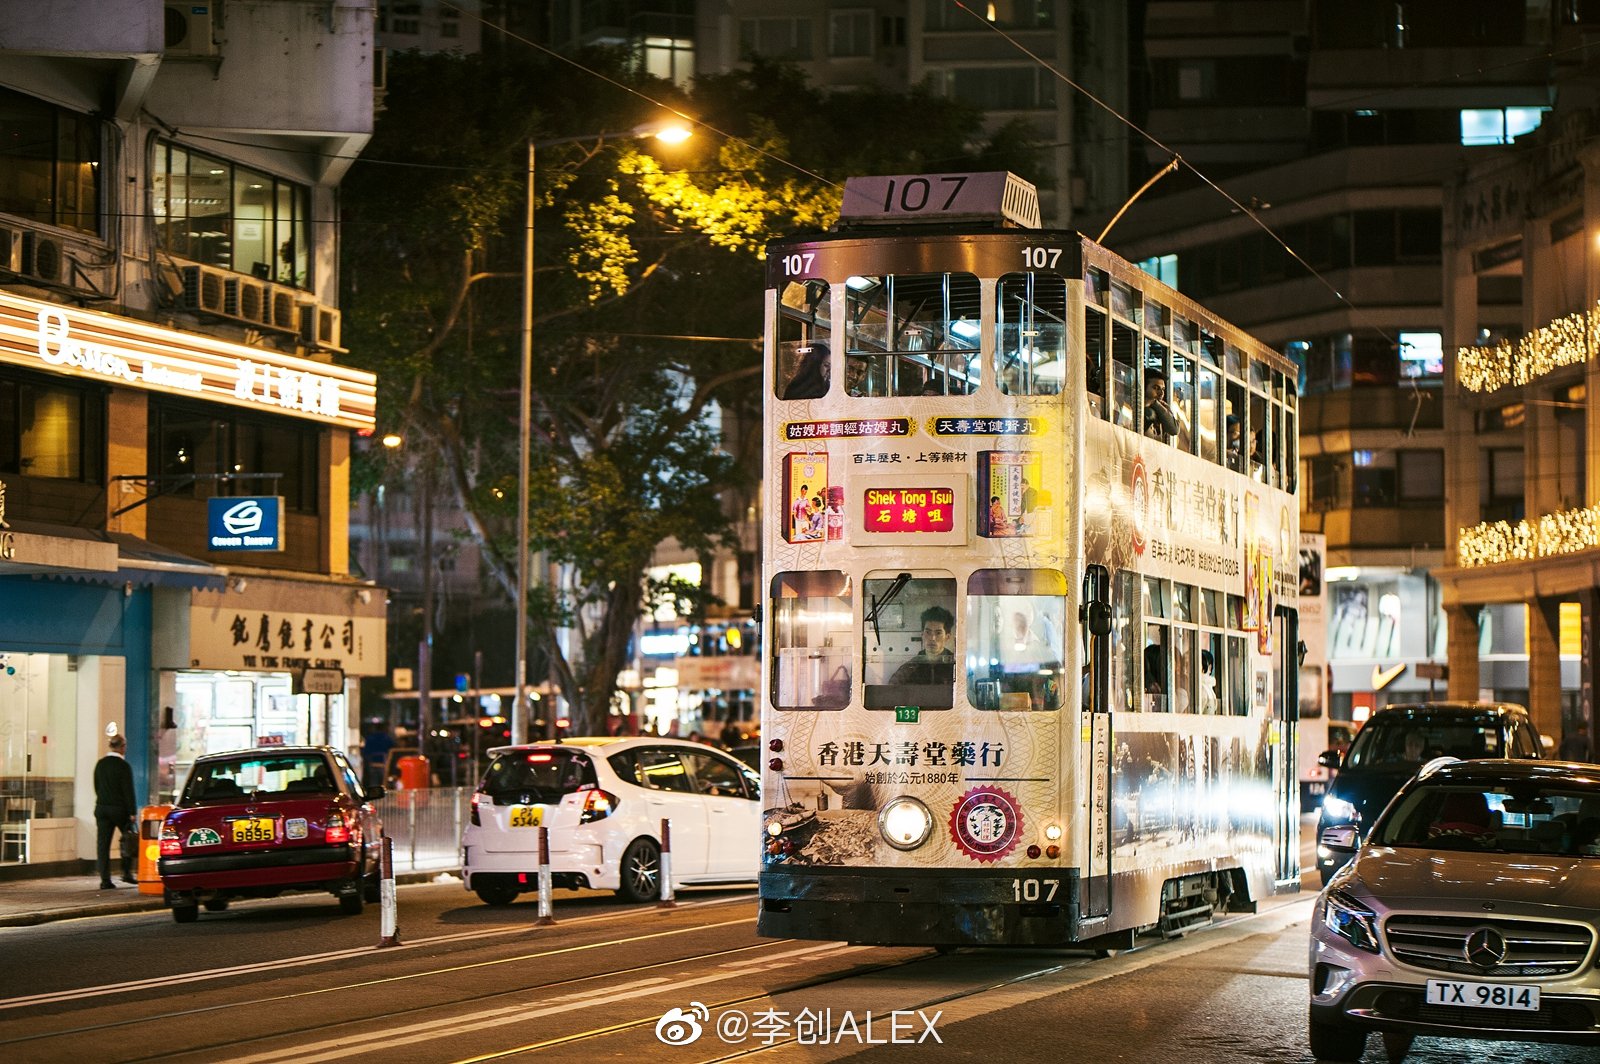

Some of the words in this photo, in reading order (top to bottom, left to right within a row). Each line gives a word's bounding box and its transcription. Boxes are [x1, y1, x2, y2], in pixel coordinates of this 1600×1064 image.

[883, 176, 968, 213] 107
[781, 253, 816, 276] 107
[1021, 247, 1063, 270] 107
[867, 490, 897, 505] Shek
[899, 490, 926, 507] Tong
[930, 489, 953, 505] Tsui
[876, 508, 944, 523] 石塘咀
[899, 709, 917, 720] 133
[817, 741, 1005, 767] 香港天壽堂藥行
[865, 772, 959, 785] 始創於公元1880年
[236, 830, 272, 842] 9895
[1012, 879, 1060, 902] 107
[1436, 983, 1465, 1003] TX
[1476, 986, 1531, 1007] 9814
